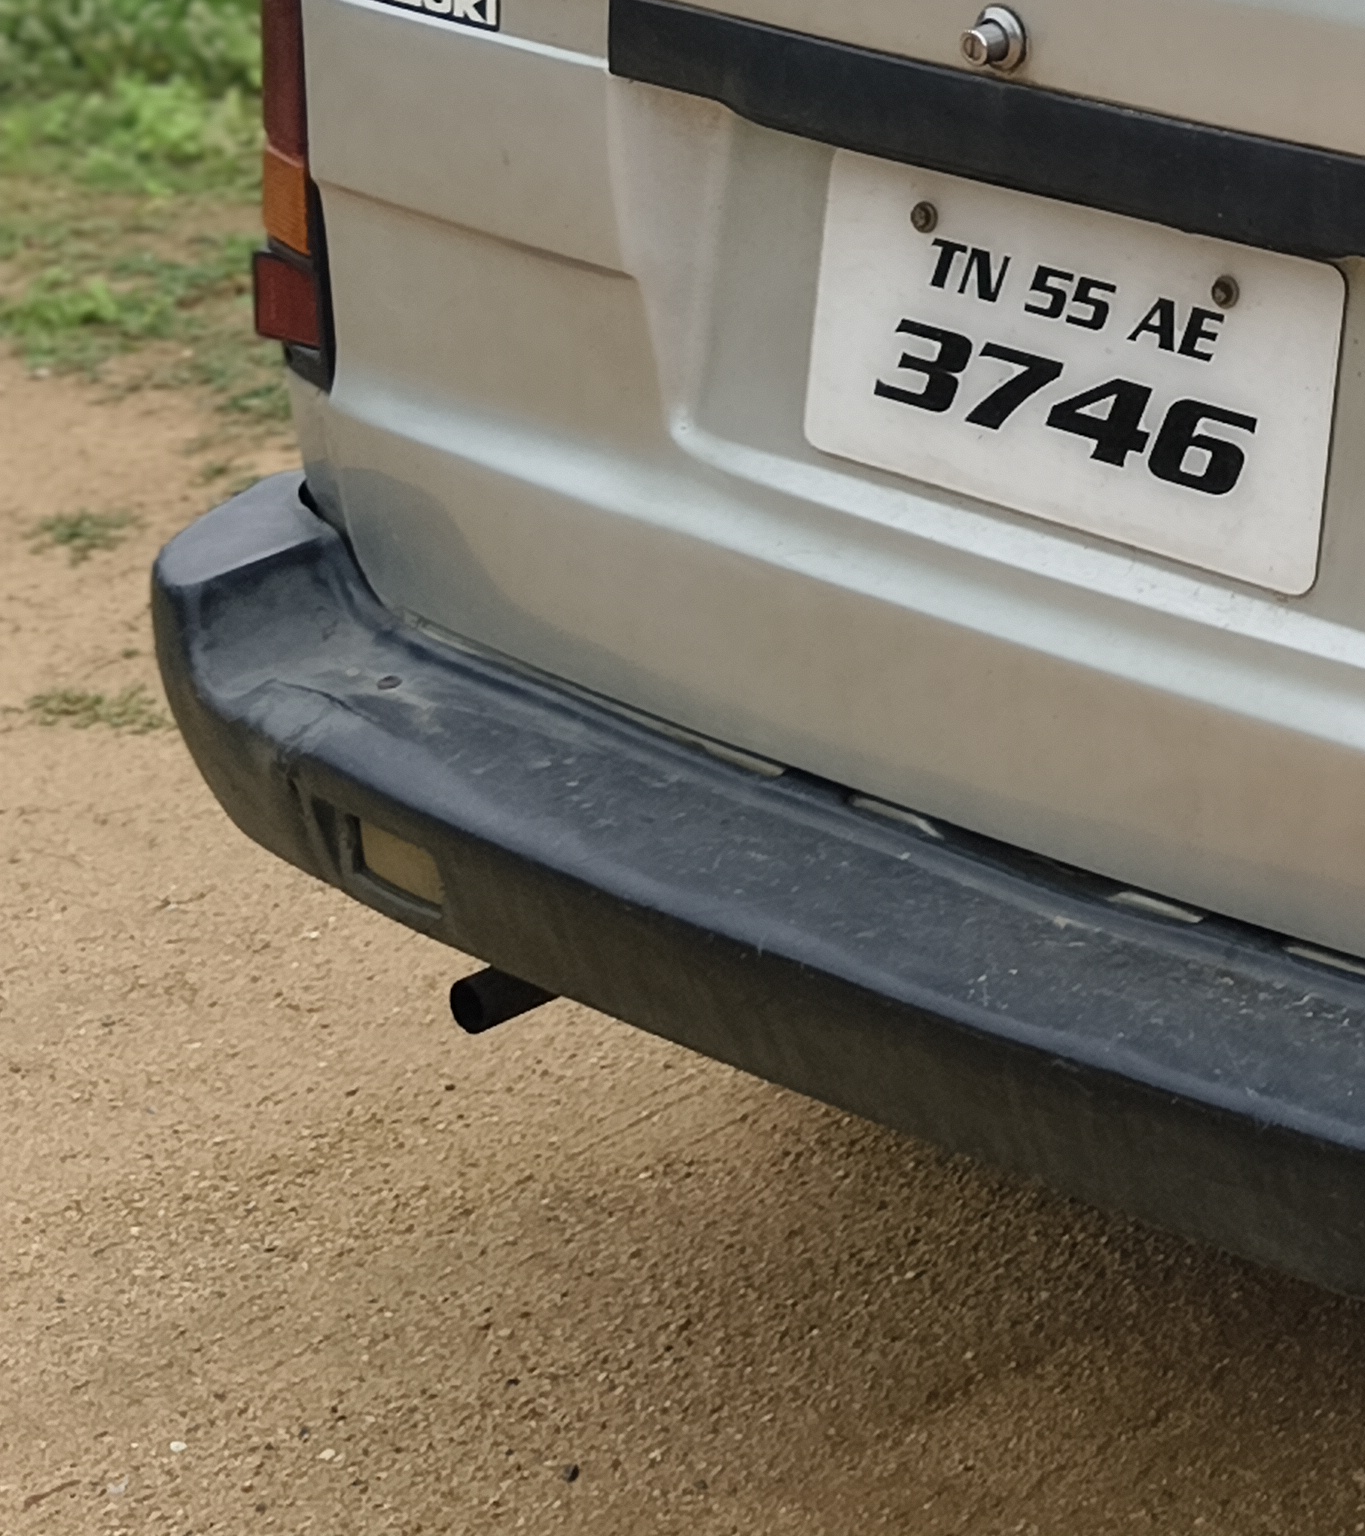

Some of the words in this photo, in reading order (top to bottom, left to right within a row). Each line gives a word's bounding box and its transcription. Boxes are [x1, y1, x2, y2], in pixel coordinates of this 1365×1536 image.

[927, 237, 1012, 304] TN
[1023, 264, 1118, 332] 55
[1126, 296, 1225, 363] AE
[873, 317, 1259, 496] 3746
